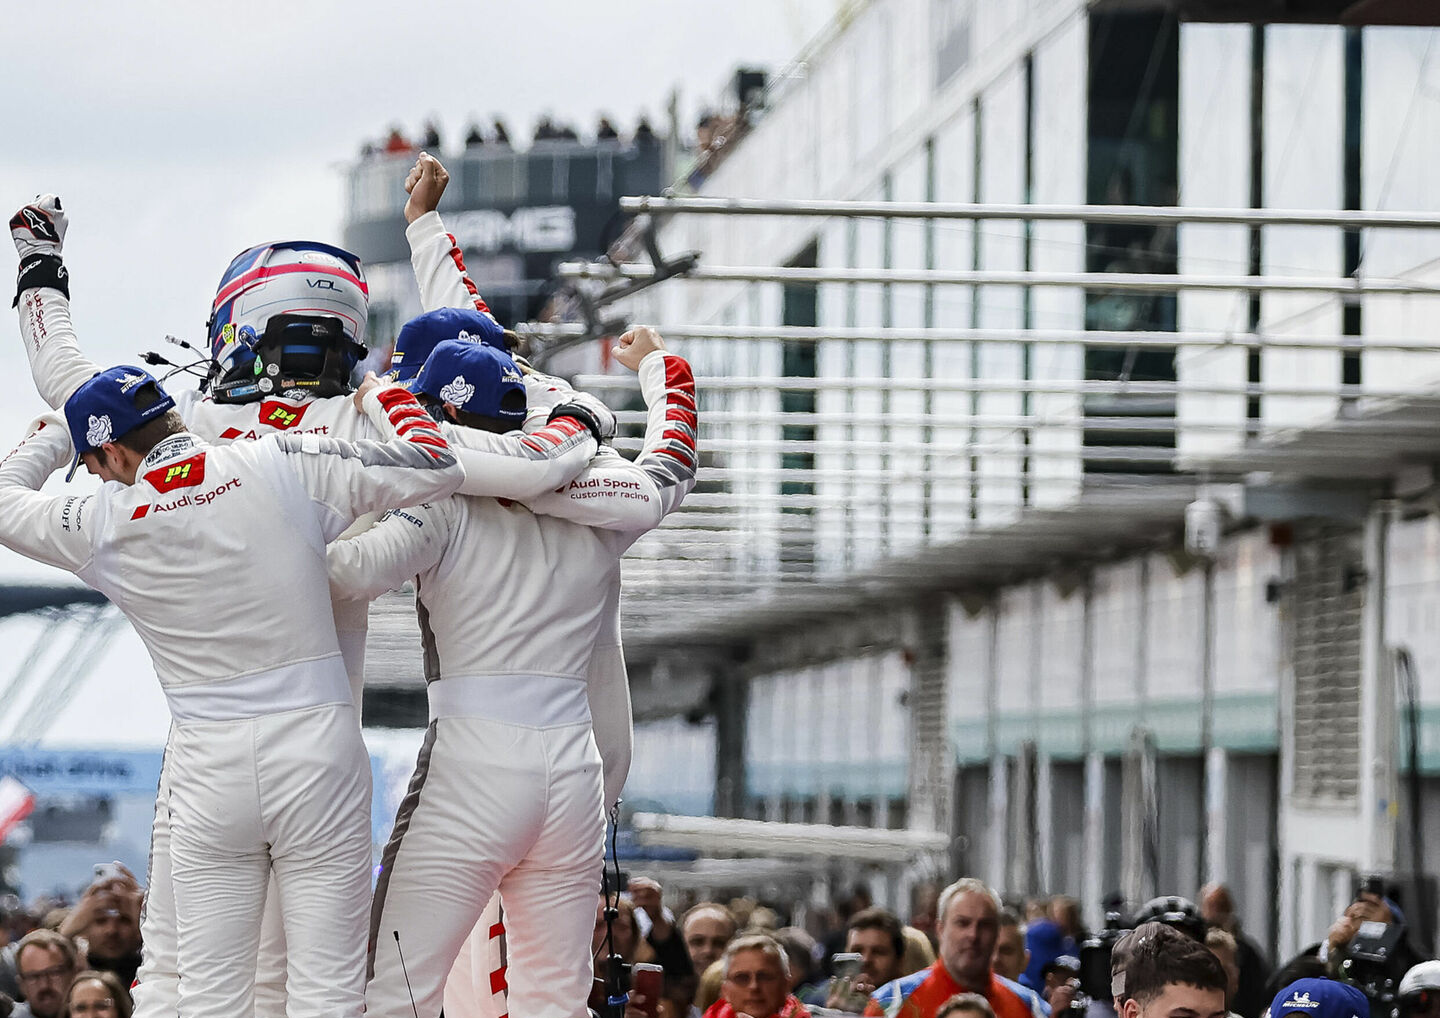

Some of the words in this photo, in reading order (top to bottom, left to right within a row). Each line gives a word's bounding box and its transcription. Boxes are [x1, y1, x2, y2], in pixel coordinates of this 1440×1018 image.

[306, 278, 343, 293] VDL
[569, 478, 599, 490] Audi
[603, 478, 641, 490] Sport
[154, 495, 192, 513] Audi
[194, 477, 242, 506] Sport
[570, 490, 617, 500] customer
[620, 491, 650, 502] racing
[389, 508, 424, 528] ERER
